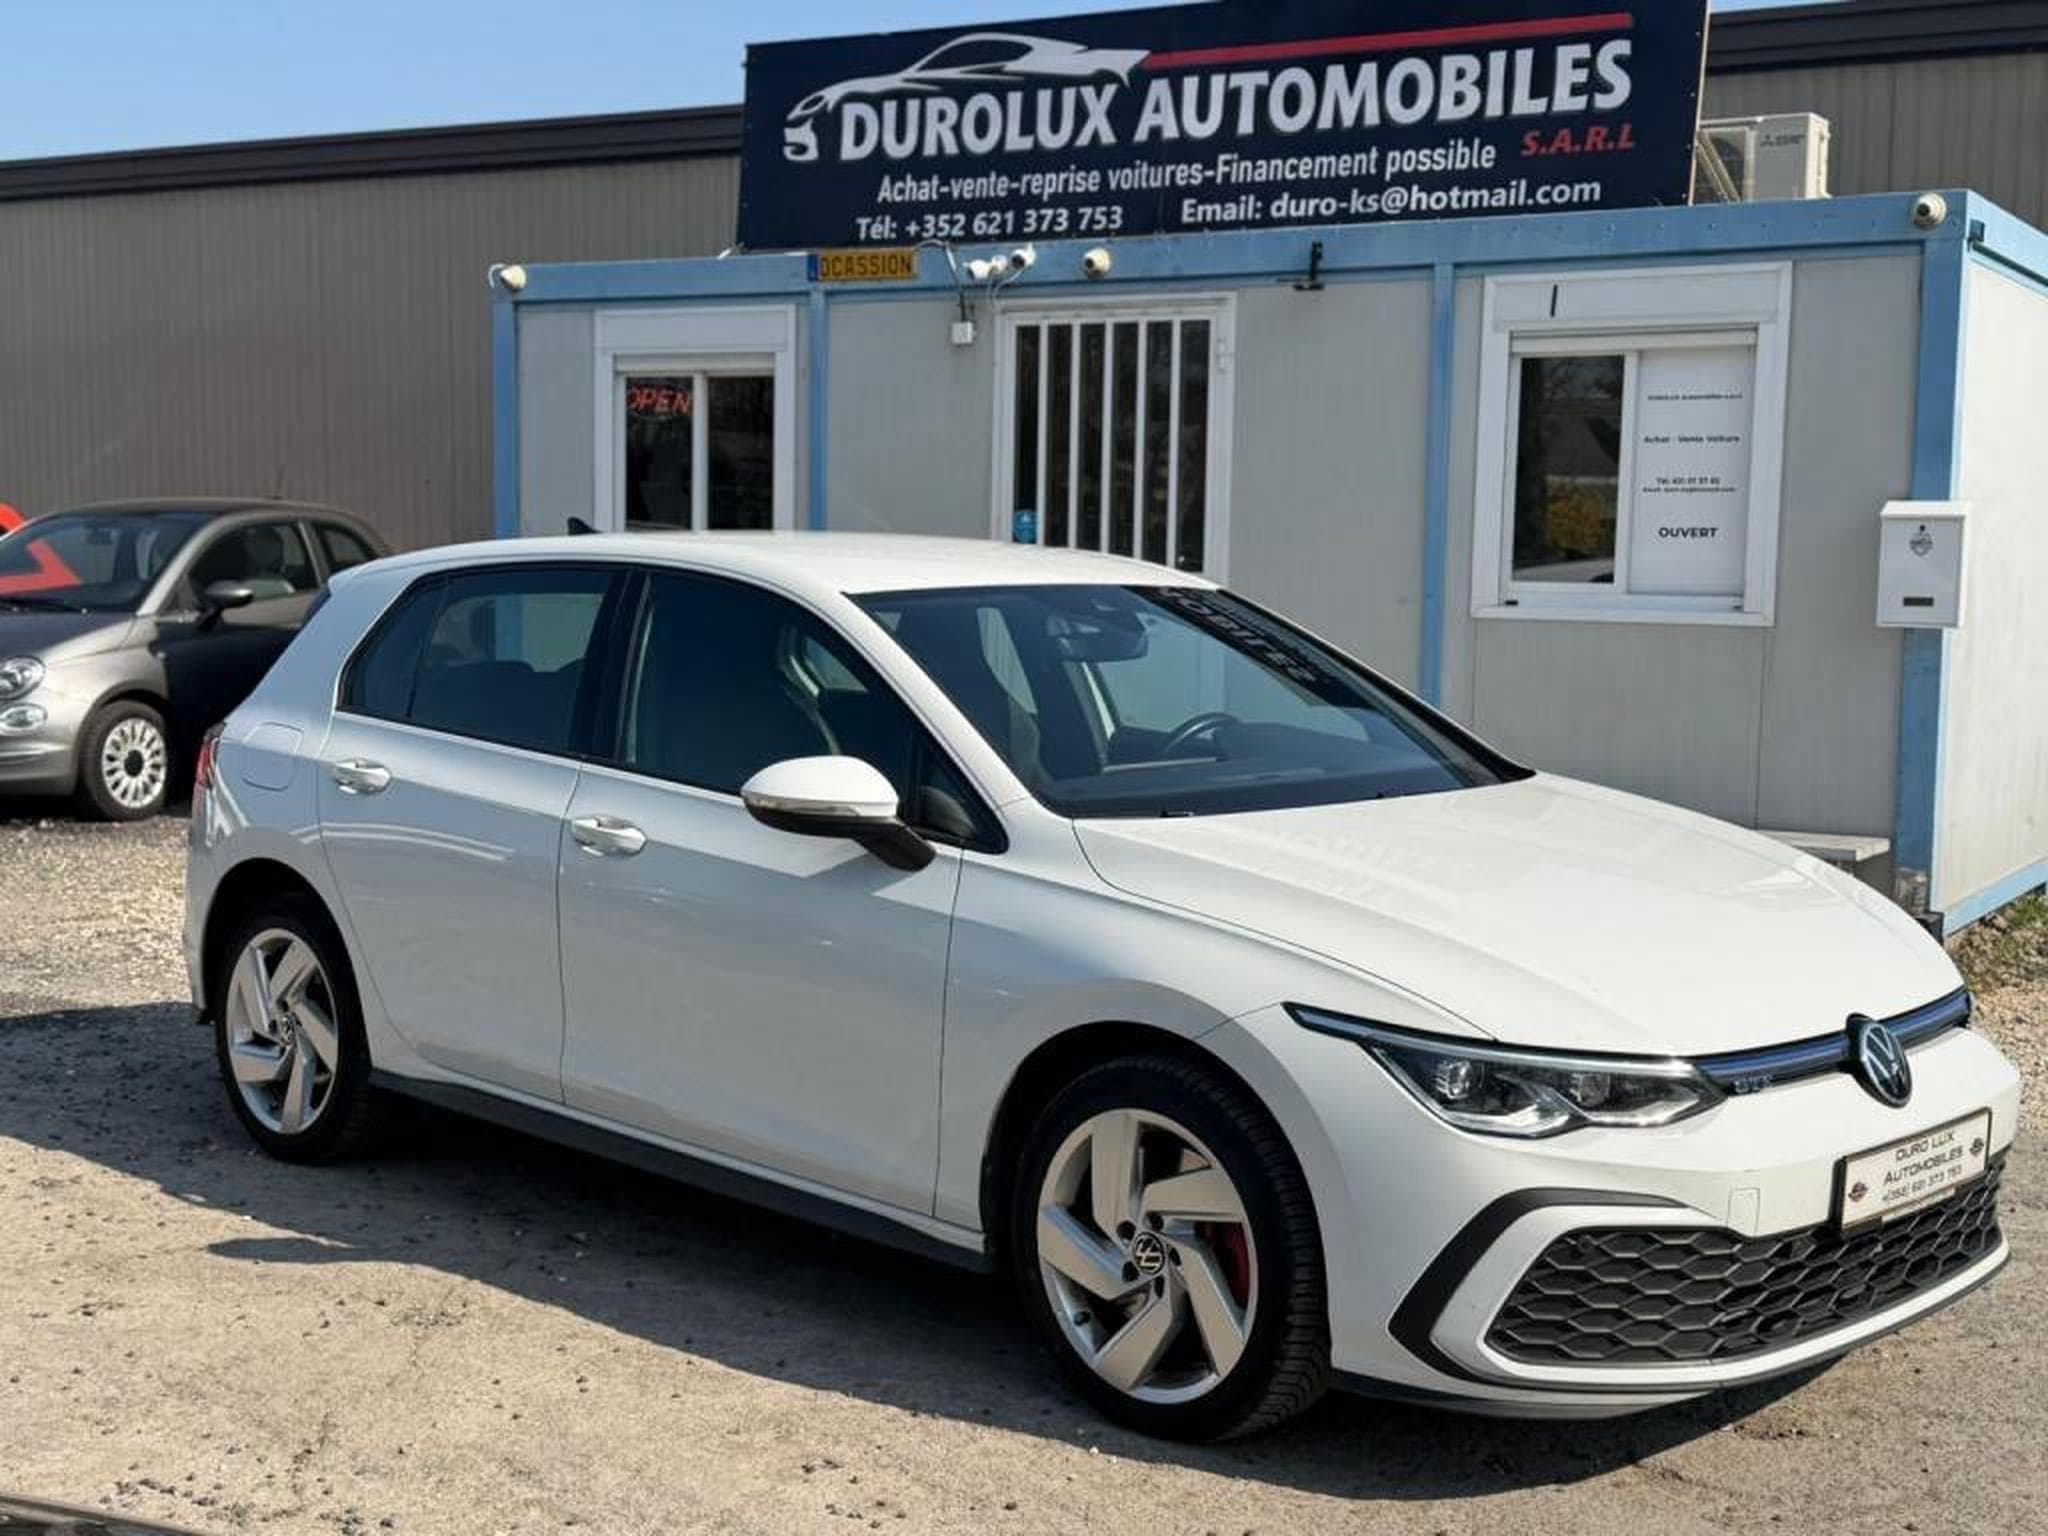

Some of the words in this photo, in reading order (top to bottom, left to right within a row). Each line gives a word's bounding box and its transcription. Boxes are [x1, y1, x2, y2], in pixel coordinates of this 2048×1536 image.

[841, 84, 1118, 160] DUROLUX
[1133, 40, 1632, 143] AUTOMOBILES
[877, 171, 1101, 202] Achat-vente-reprise
[1108, 147, 1379, 191] voitures-Financement
[1384, 138, 1496, 182] possible
[1181, 197, 1262, 223] Email:
[1270, 178, 1601, 217] duro-ks@hotmail.com
[856, 215, 898, 240] Tél:
[905, 214, 966, 237] +352
[972, 210, 1014, 235] 621
[1023, 207, 1069, 232] 373
[1078, 205, 1123, 231] 753
[627, 388, 691, 413] OPEN
[1658, 527, 1718, 538] OUVERT
